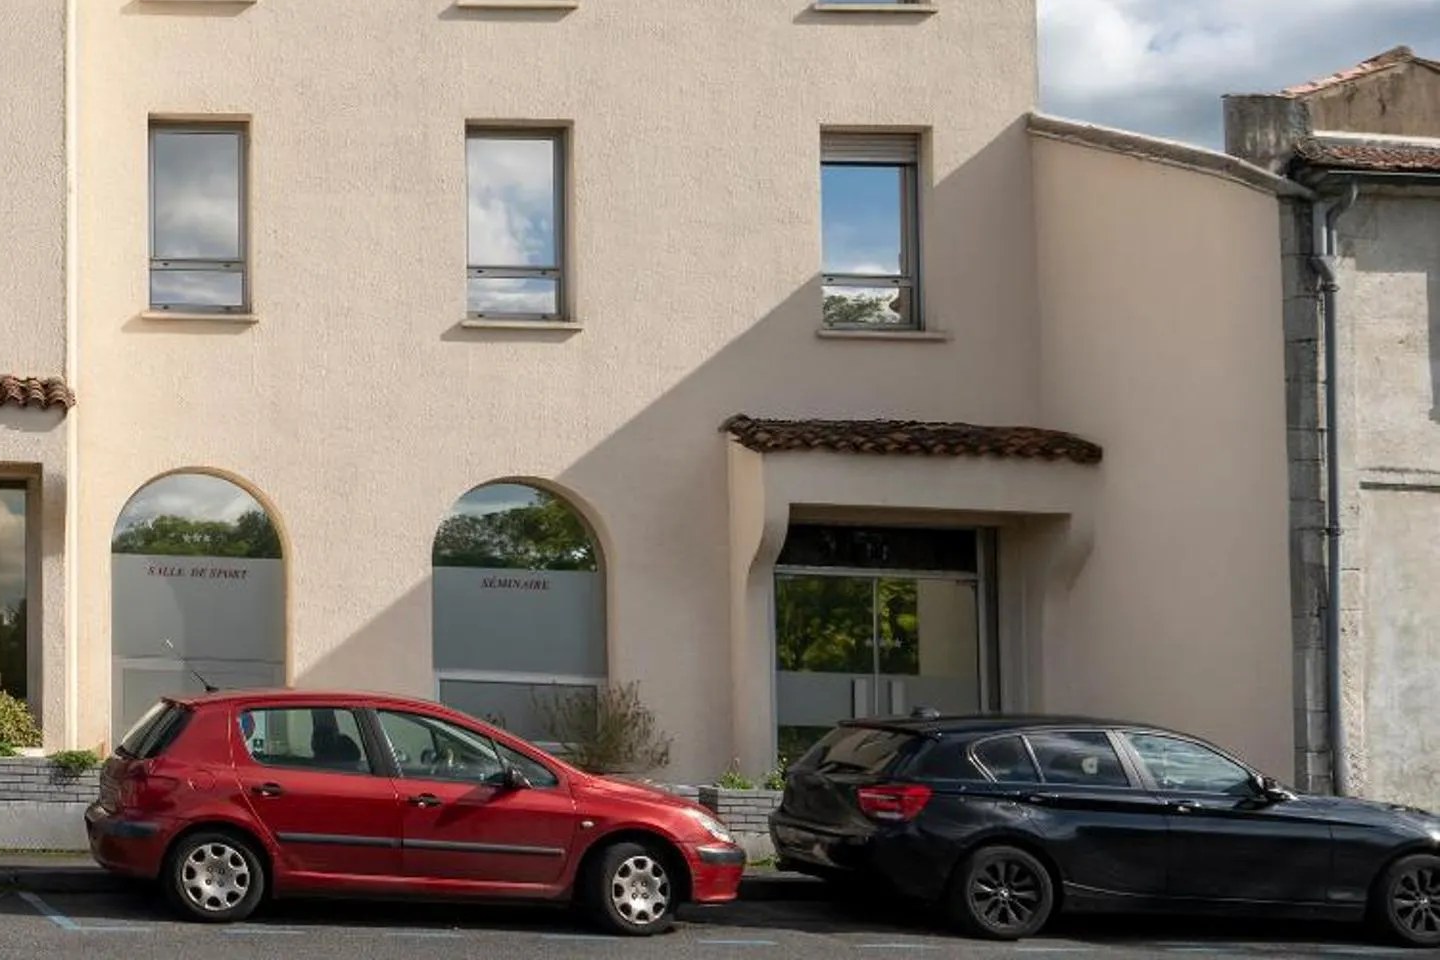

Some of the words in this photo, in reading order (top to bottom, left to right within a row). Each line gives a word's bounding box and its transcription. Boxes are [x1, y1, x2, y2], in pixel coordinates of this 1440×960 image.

[148, 566, 185, 577] SALLE
[190, 567, 207, 577] DE
[209, 567, 247, 579] SPORT
